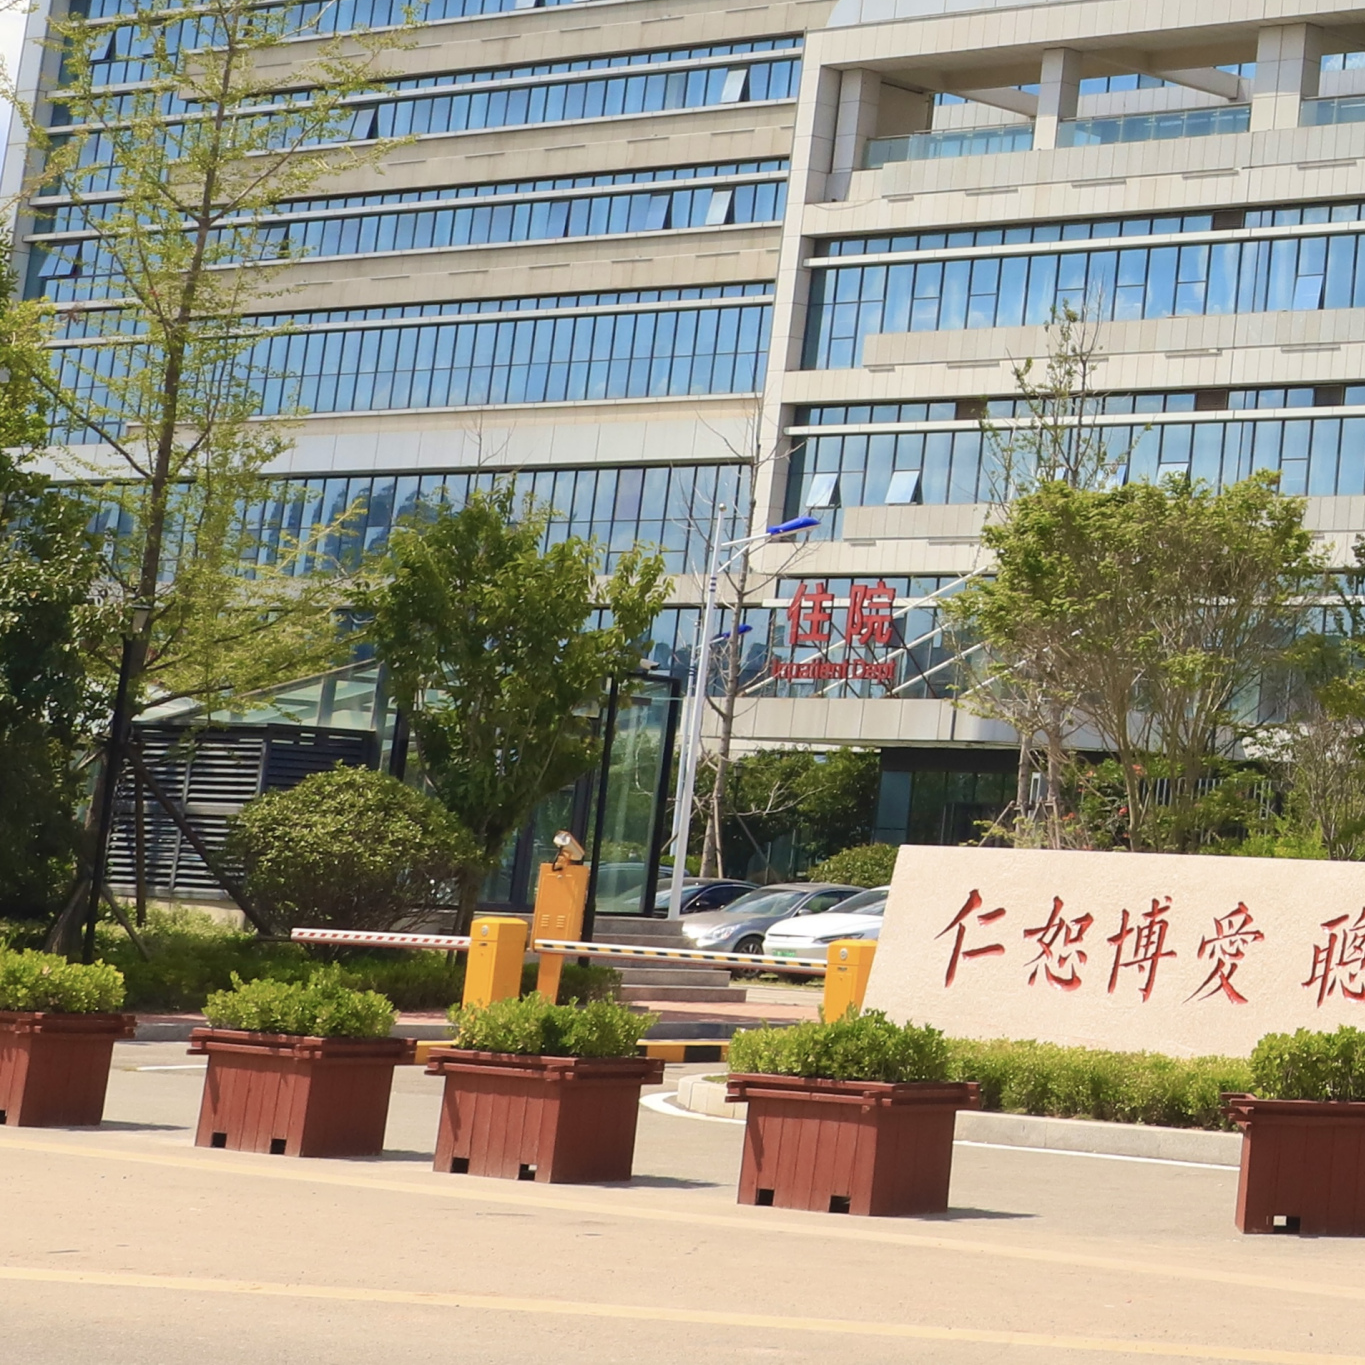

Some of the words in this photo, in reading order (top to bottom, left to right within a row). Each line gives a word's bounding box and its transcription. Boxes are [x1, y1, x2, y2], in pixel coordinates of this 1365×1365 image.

[787, 580, 896, 645] 住院
[771, 658, 848, 683] Inpatient
[852, 659, 896, 683] Dept
